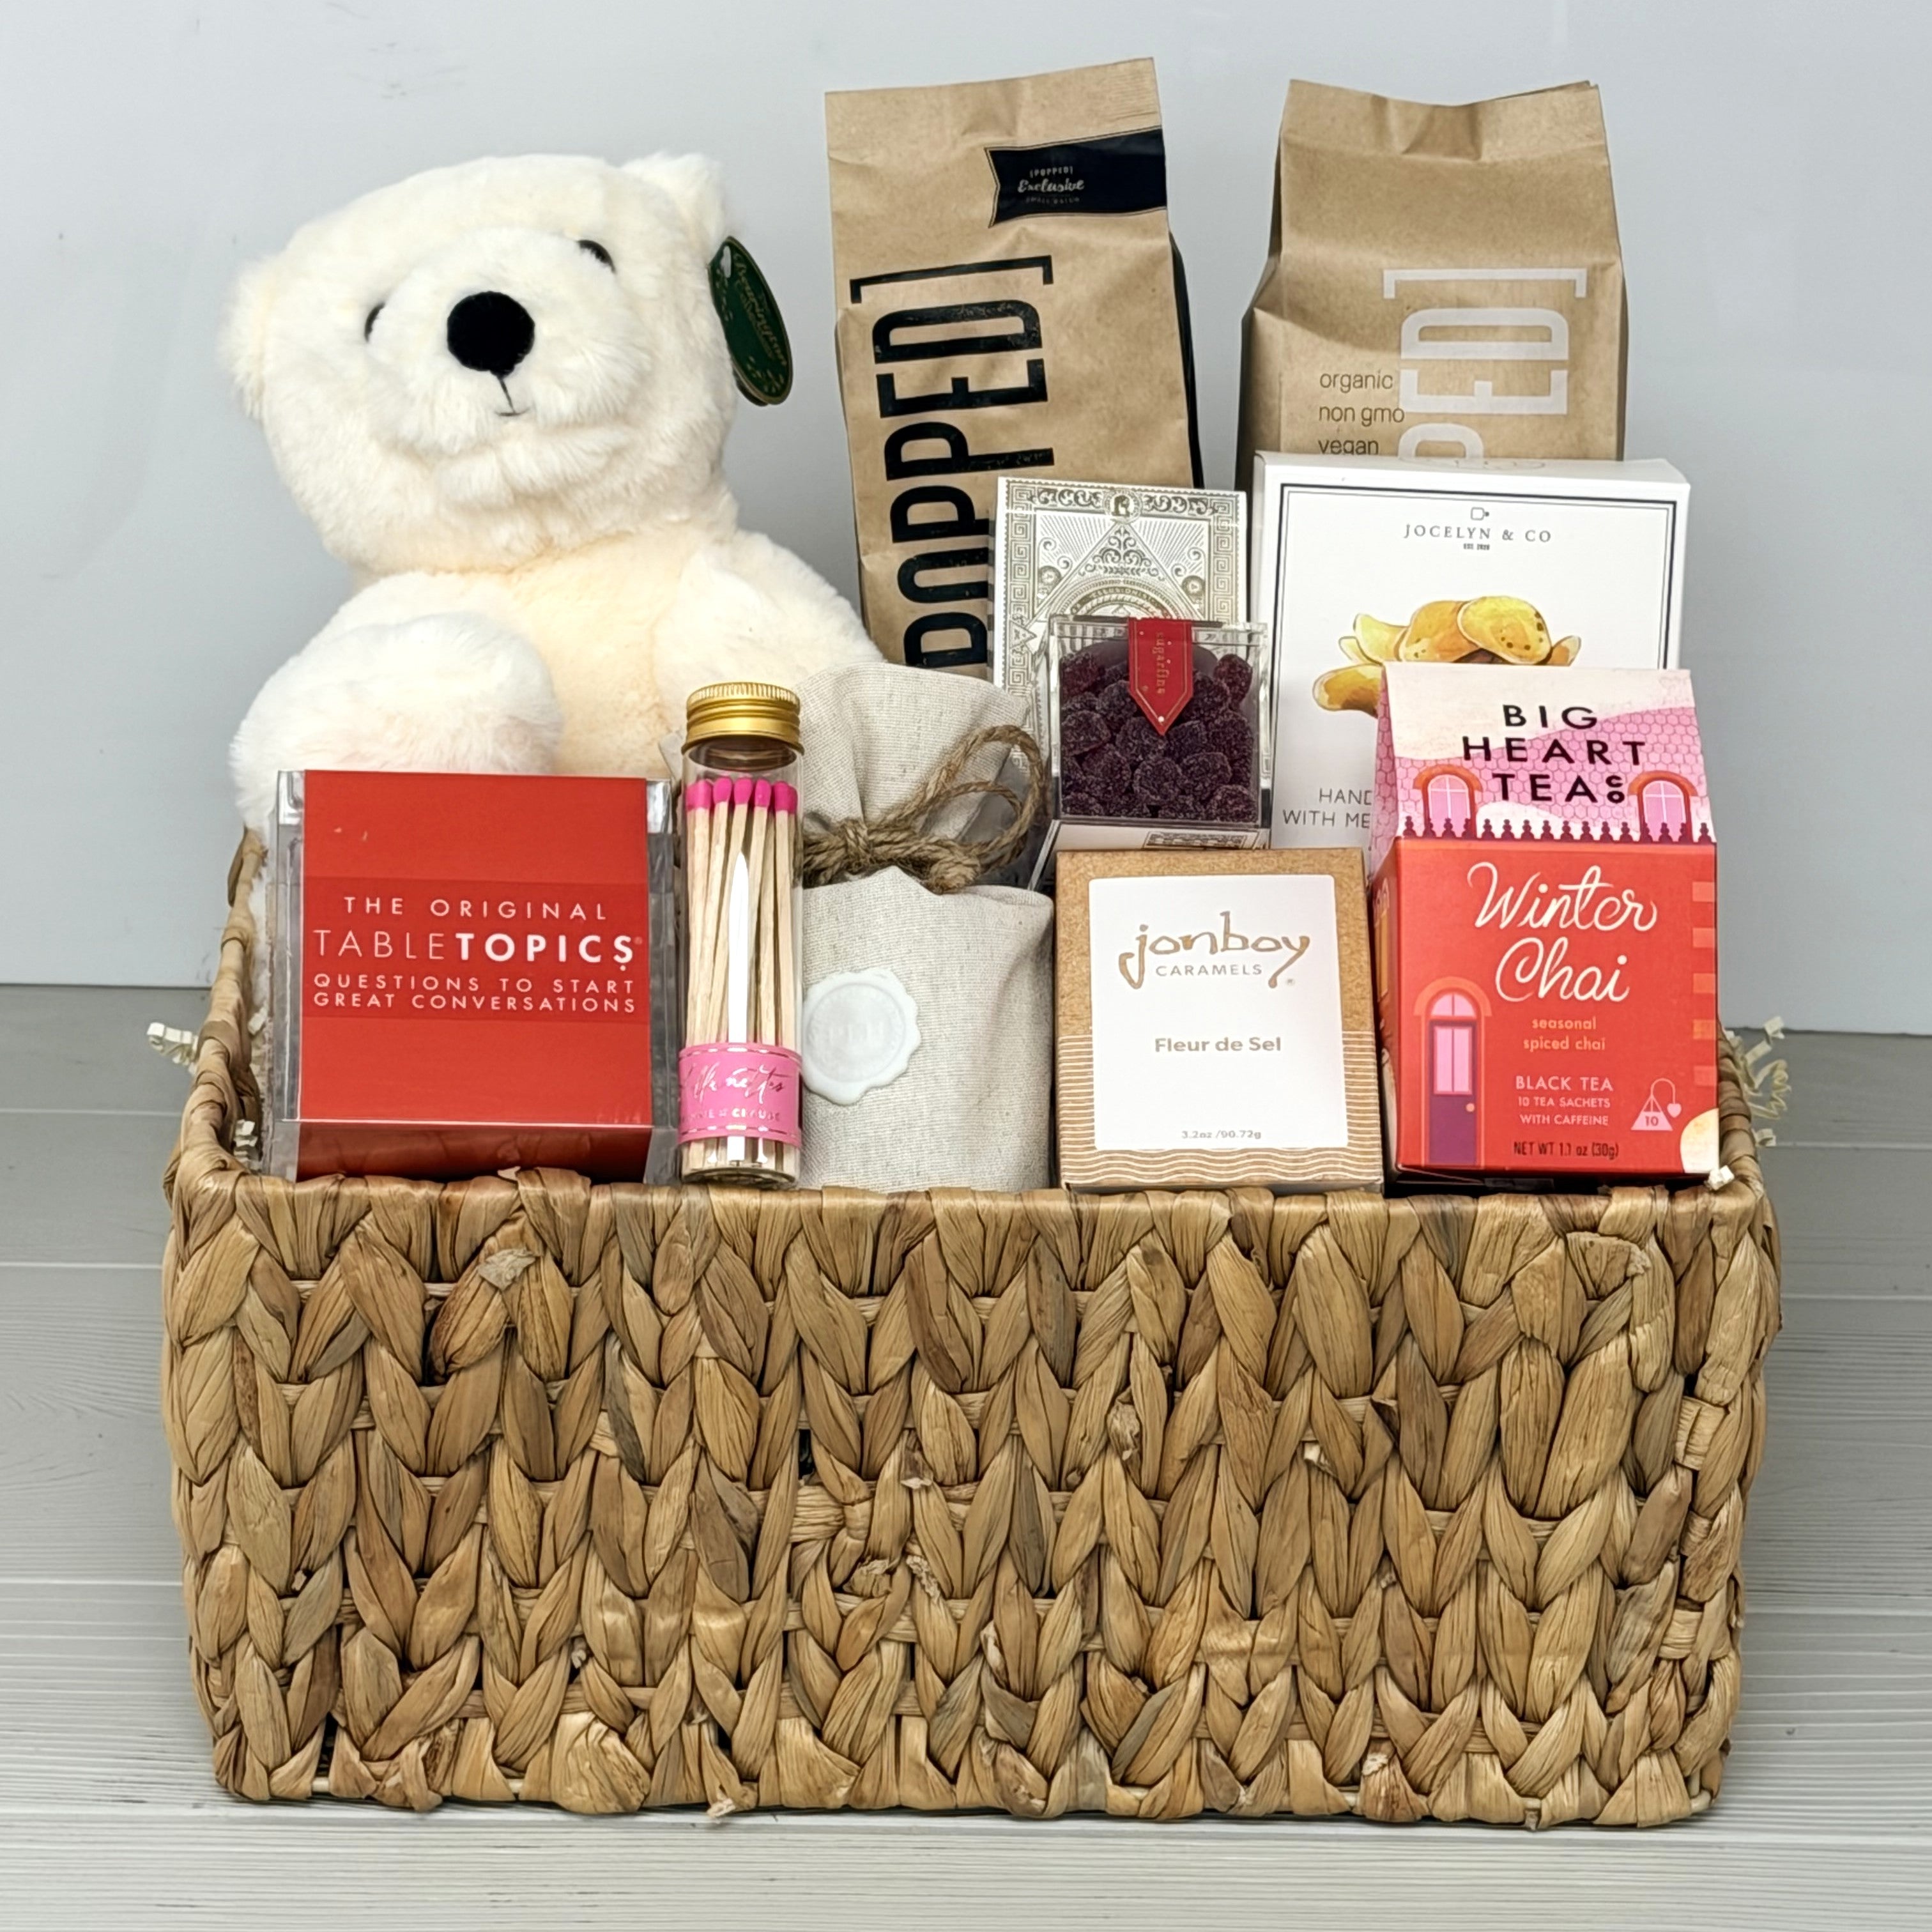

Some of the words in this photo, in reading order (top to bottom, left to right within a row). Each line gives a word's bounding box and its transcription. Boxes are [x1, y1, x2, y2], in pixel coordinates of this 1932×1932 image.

[1017, 178, 1085, 193] Exclusive
[1319, 369, 1393, 394] organic
[1319, 406, 1356, 422] non
[1361, 407, 1405, 427] gmo
[1317, 439, 1379, 456] vegan
[1404, 523, 1491, 540] JOCELYN
[1501, 529, 1514, 541] &
[1524, 530, 1551, 543] CO
[1503, 705, 1597, 730] BIG
[1462, 735, 1646, 767] HEART
[1491, 772, 1597, 803] TEA
[1282, 809, 1336, 827] WITH
[1467, 862, 1657, 931] Winter
[344, 896, 403, 915] THE
[430, 899, 606, 921] ORIGINAL
[312, 929, 634, 971] TABLETOPICS
[1118, 911, 1310, 990] jonboy
[1155, 963, 1263, 977] CARAMELS
[1496, 937, 1630, 1002] Chai
[314, 973, 479, 992] QUESTIONS
[500, 978, 532, 992] TO
[553, 979, 633, 993] START
[314, 992, 395, 1008] GREAT
[411, 994, 635, 1013] CONVERSATIONS
[1531, 1016, 1597, 1030] seasonal
[1155, 1038, 1210, 1054] Fleur
[1215, 1038, 1243, 1052] de
[1248, 1037, 1282, 1052] Sel
[1523, 1035, 1570, 1053] spiced
[1575, 1036, 1606, 1051] chai
[1515, 1075, 1572, 1091] BLACK
[1579, 1077, 1614, 1092] TEA
[1533, 1096, 1554, 1107] TEA
[1559, 1097, 1611, 1108] SACHETS
[1520, 1114, 1550, 1125] WITH
[1553, 1115, 1609, 1126] CAFFEINE
[1645, 1116, 1659, 1127] 10
[1514, 1141, 1535, 1155] NET
[1538, 1142, 1554, 1156] WT
[1576, 1146, 1588, 1157] oz
[1591, 1142, 1620, 1160] (30g)
